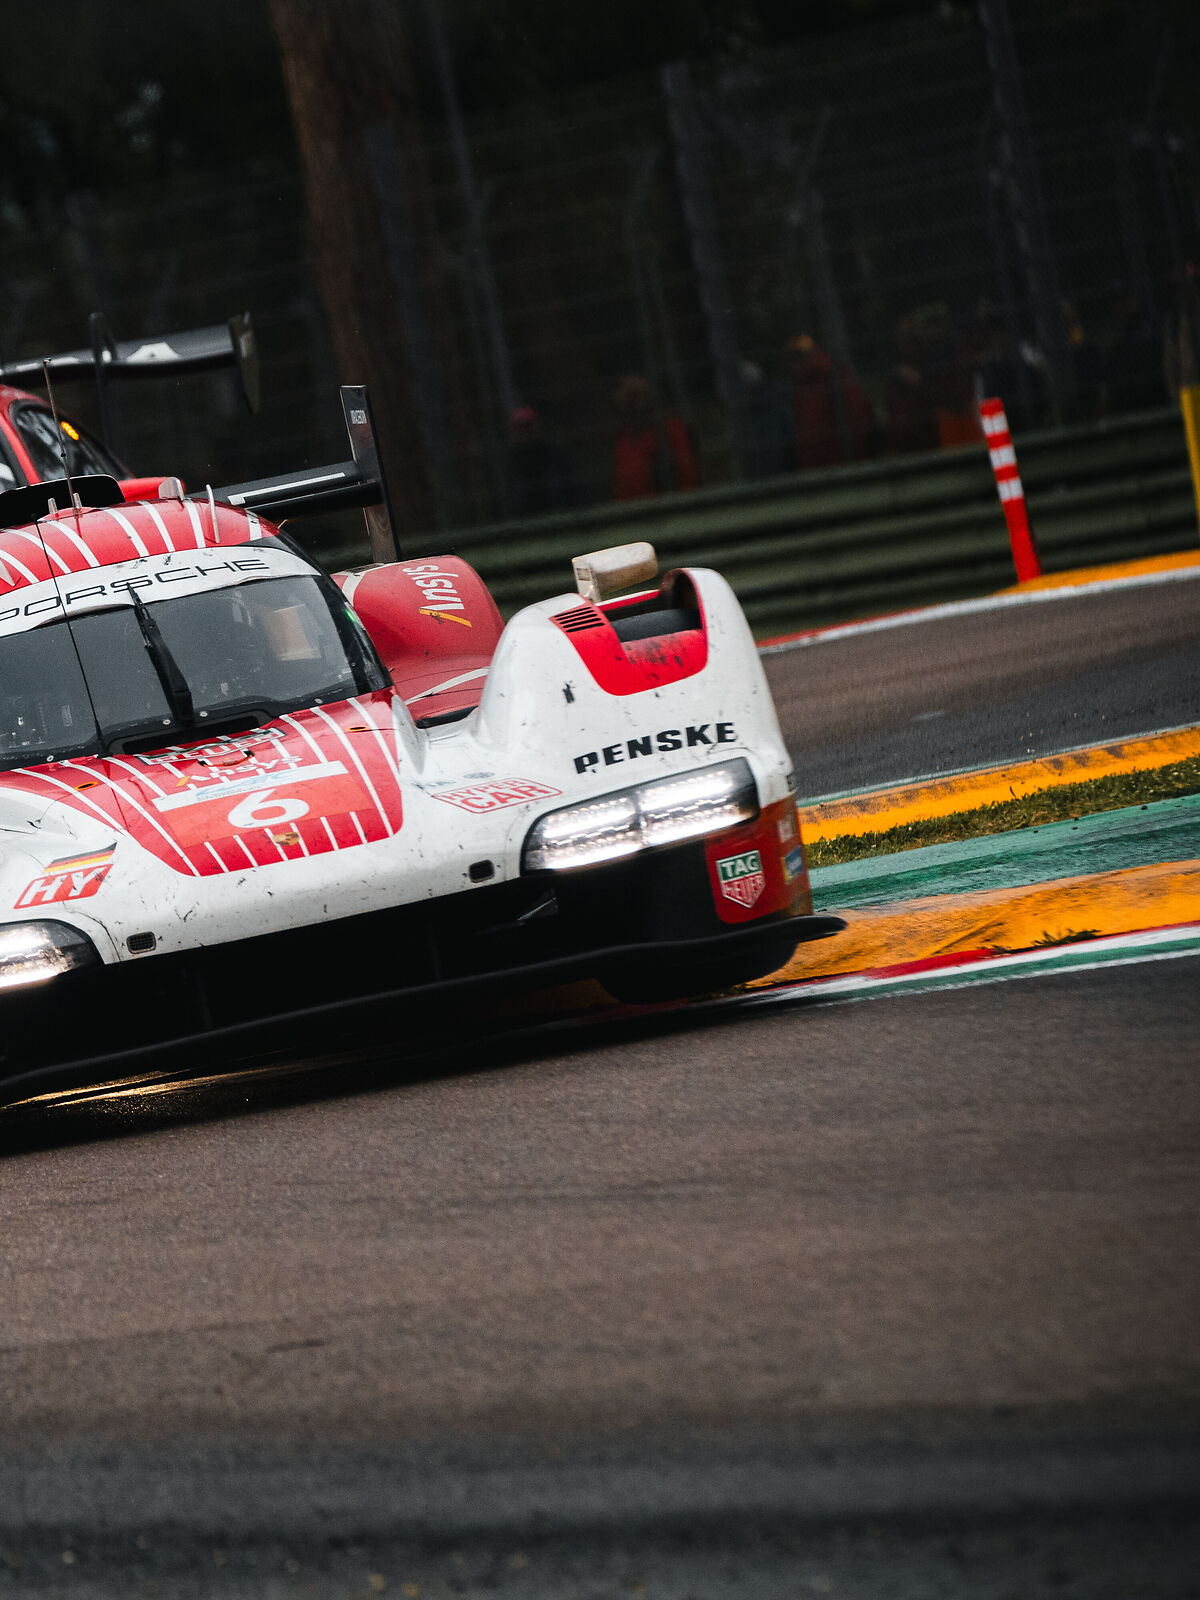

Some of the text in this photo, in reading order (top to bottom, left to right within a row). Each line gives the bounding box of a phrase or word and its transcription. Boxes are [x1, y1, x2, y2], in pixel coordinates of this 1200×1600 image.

[573, 722, 740, 774] PENSKE
[439, 779, 528, 801] HYPER
[459, 785, 550, 810] CAR
[227, 788, 311, 830] 6
[721, 857, 761, 880] TAG
[19, 866, 108, 906] HY
